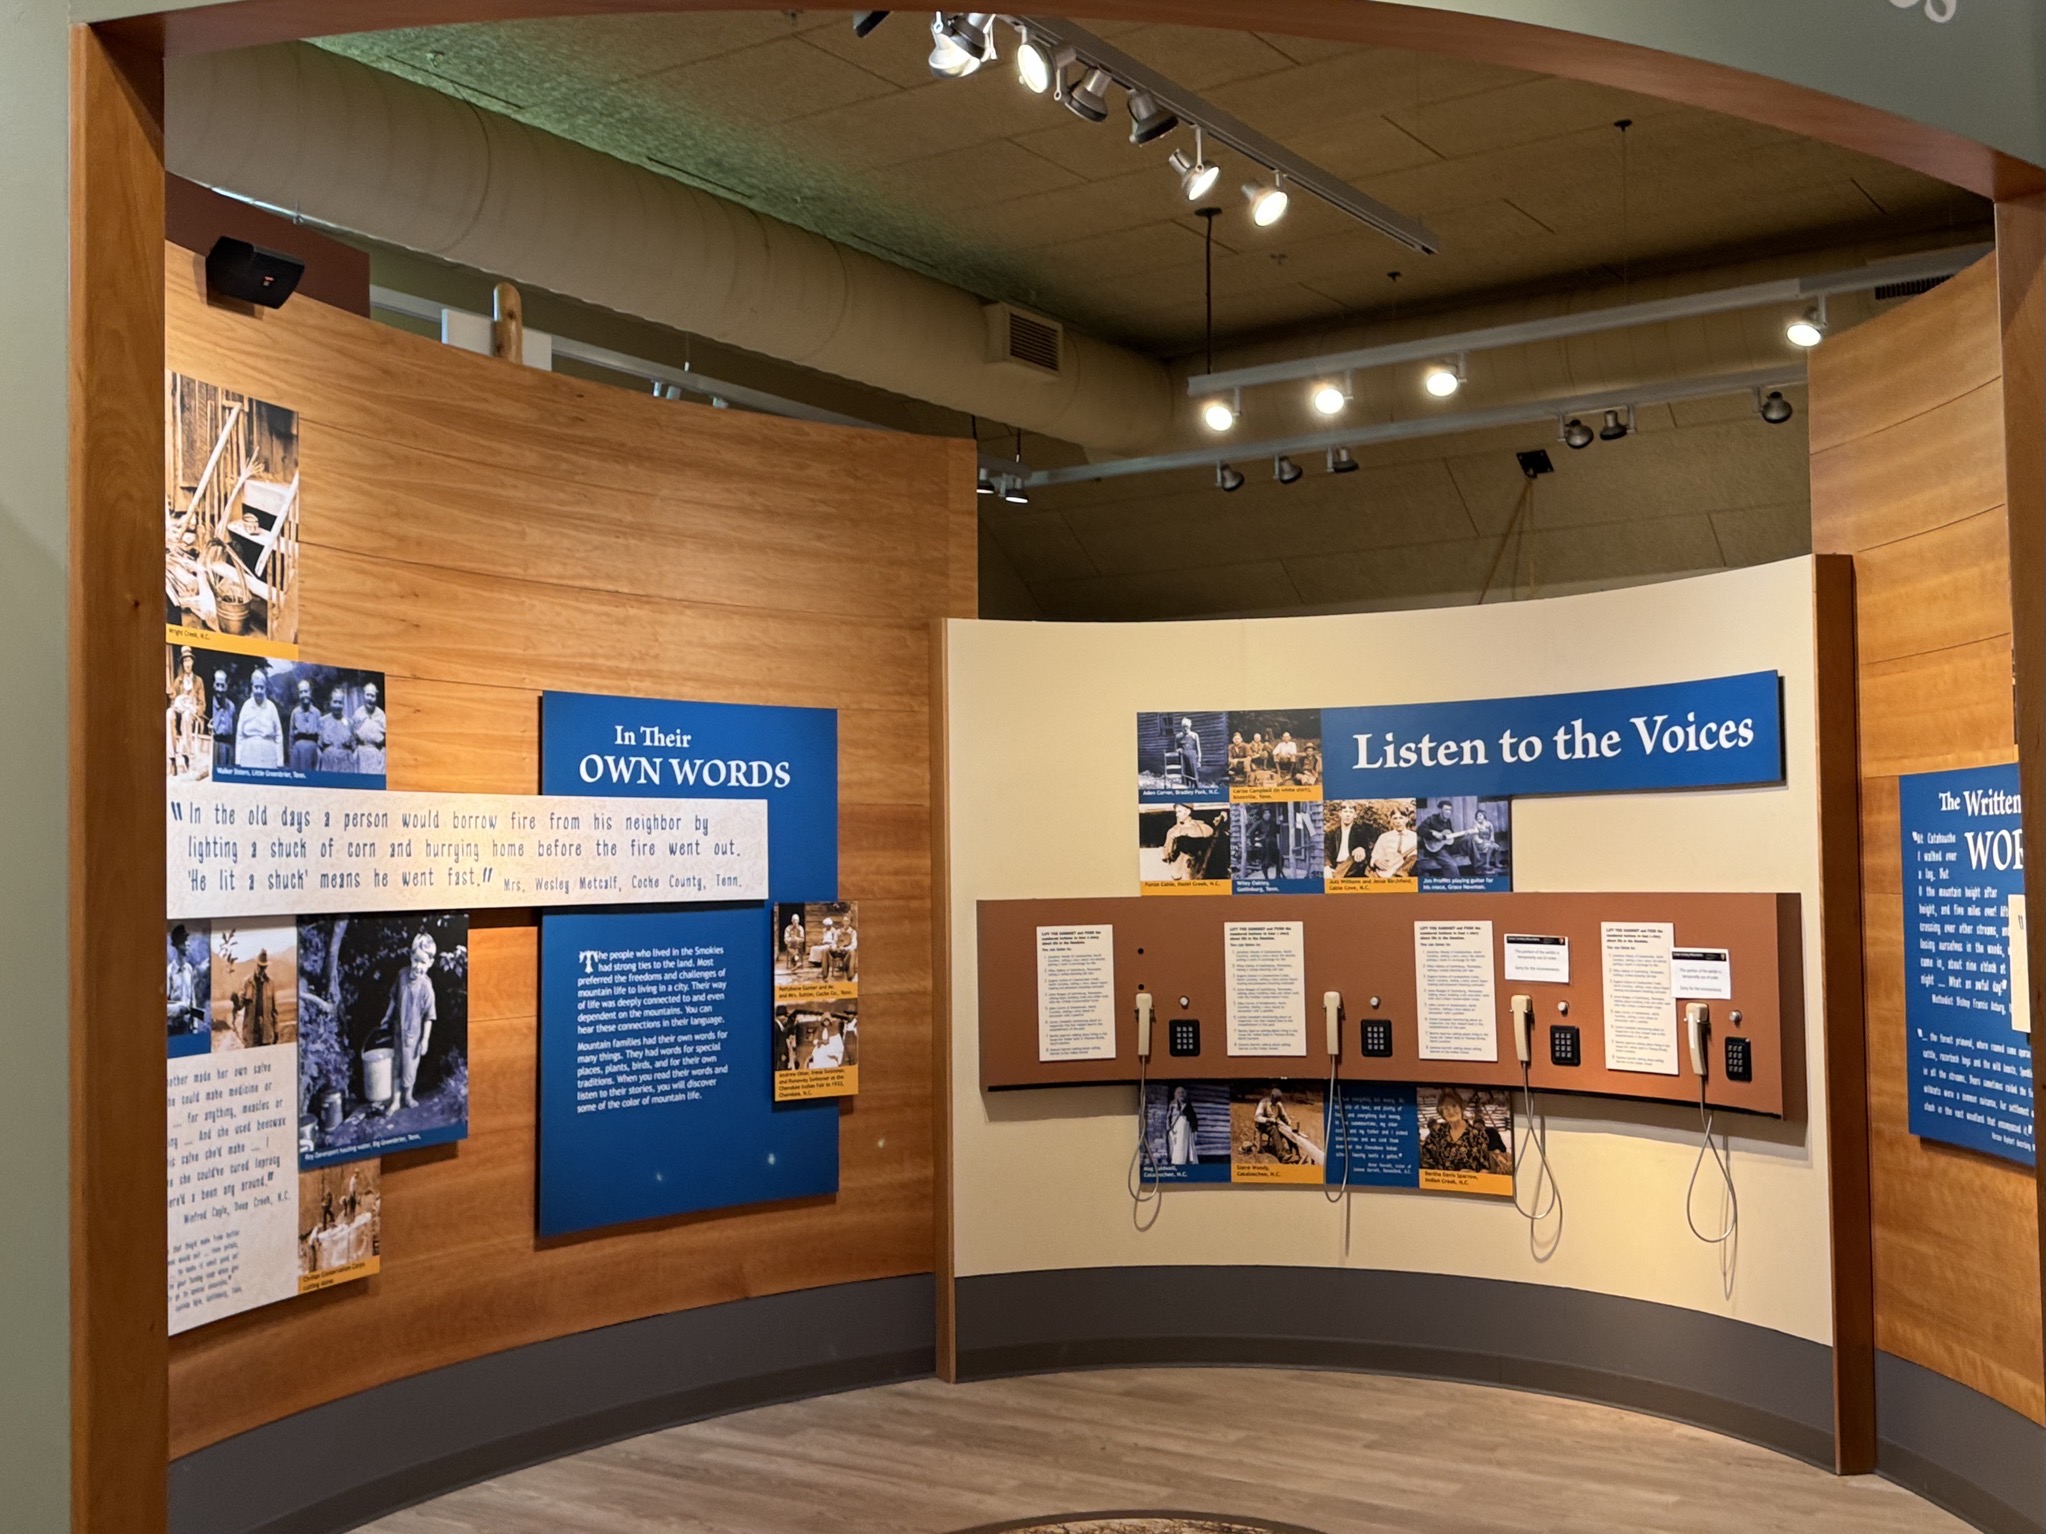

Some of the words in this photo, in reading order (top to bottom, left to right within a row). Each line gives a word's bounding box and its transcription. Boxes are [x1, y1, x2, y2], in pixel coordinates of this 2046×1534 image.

[614, 725, 637, 746] In
[640, 726, 692, 748] Their
[1352, 732, 1489, 770] Listen
[1498, 729, 1543, 763] to
[1553, 718, 1622, 760] the
[1629, 711, 1754, 756] Voices
[216, 767, 233, 775] Walker
[251, 769, 265, 777] Little
[579, 753, 663, 785] OWN
[668, 758, 791, 789] WORDS
[1938, 791, 1961, 811] The
[1962, 788, 2022, 817] Written
[171, 801, 201, 825] "In
[214, 802, 236, 826] the
[248, 804, 268, 826] old
[281, 805, 311, 834] days
[324, 811, 331, 828] a
[344, 811, 388, 832] person
[401, 809, 440, 830] would
[453, 811, 498, 830] borrow
[511, 811, 536, 830] fire
[549, 812, 580, 831] from
[593, 813, 613, 831] his
[625, 814, 682, 835] neighbor
[694, 814, 709, 837] by
[188, 836, 238, 864] lighting
[251, 841, 257, 858] a
[270, 837, 307, 858] shuck
[320, 837, 334, 858] of
[347, 840, 376, 858] corn
[389, 838, 412, 858] and
[425, 838, 479, 863] hurrying
[492, 839, 524, 857] home
[538, 839, 582, 857] before
[596, 839, 617, 857] the
[630, 838, 656, 857] fire
[669, 839, 701, 856] went
[713, 839, 742, 857] out.
[1924, 850, 1942, 862] walked
[188, 868, 207, 891] 'He
[219, 869, 236, 891] lit
[248, 873, 255, 891] a
[267, 868, 309, 891] shuck'
[320, 869, 361, 889] means
[374, 868, 388, 888] he
[402, 867, 434, 887] went
[504, 878, 526, 893] Mrs.
[535, 877, 570, 894] Wesley
[579, 876, 622, 892] Metcalf,
[631, 875, 660, 889] Cocke
[669, 874, 706, 891] County,
[716, 873, 743, 888] Tenn.
[1926, 885, 1935, 897] the
[1939, 886, 1962, 898] mountain
[1965, 886, 1981, 900] height
[579, 950, 608, 973] The
[609, 950, 634, 961] people
[636, 949, 651, 958] who
[652, 947, 670, 957] lived
[672, 947, 679, 956] in
[681, 947, 693, 956] the
[695, 945, 724, 955] Smokies
[598, 963, 612, 972] had
[613, 961, 636, 973] strong
[638, 960, 651, 970] ties
[653, 960, 661, 969] to
[663, 959, 675, 968] the
[677, 958, 695, 967] land.
[696, 958, 714, 966] Most
[577, 973, 613, 987] preferred
[614, 973, 627, 983] the
[628, 972, 662, 982] freedoms
[664, 971, 677, 980] and
[679, 969, 716, 980] challenges
[718, 968, 726, 977] of
[577, 986, 612, 998] mountain
[613, 985, 626, 995] life
[628, 985, 636, 994] to
[637, 983, 657, 994] living
[659, 983, 666, 992] in
[674, 982, 689, 992] city.
[691, 981, 710, 990] Their
[712, 981, 727, 990] way
[577, 1001, 586, 1010] of
[587, 999, 600, 1009] life
[601, 999, 615, 1008] was
[617, 997, 642, 1008] deeply
[643, 995, 681, 1005] connected
[682, 994, 691, 1002] to
[692, 993, 706, 1001] and
[577, 1012, 617, 1023] dependent
[618, 1011, 628, 1019] on
[629, 1009, 642, 1018] the
[643, 1007, 683, 1017] mountains.
[684, 1006, 698, 1014] You
[699, 1005, 712, 1013] can
[577, 1025, 594, 1034] hear
[596, 1024, 616, 1033] these
[618, 1021, 661, 1031] connections
[662, 1019, 670, 1027] in
[671, 1018, 688, 1027] their
[690, 1016, 725, 1026] language.
[577, 1042, 611, 1052] Mountain
[613, 1039, 641, 1048] families
[643, 1036, 656, 1045] had
[658, 1035, 675, 1044] their
[677, 1035, 692, 1043] own
[694, 1032, 716, 1041] words
[717, 1030, 728, 1039] for
[194, 1070, 211, 1083] made
[217, 1068, 228, 1079] her
[234, 1066, 247, 1077] own
[253, 1062, 271, 1074] salve
[181, 1091, 199, 1105] could
[206, 1089, 223, 1101] make
[229, 1084, 258, 1096] medicine
[188, 1112, 198, 1124] for
[242, 1100, 270, 1114] measles
[199, 1127, 211, 1141] And
[217, 1126, 229, 1138] she
[235, 1121, 251, 1134] used
[257, 1117, 286, 1131] beeswax
